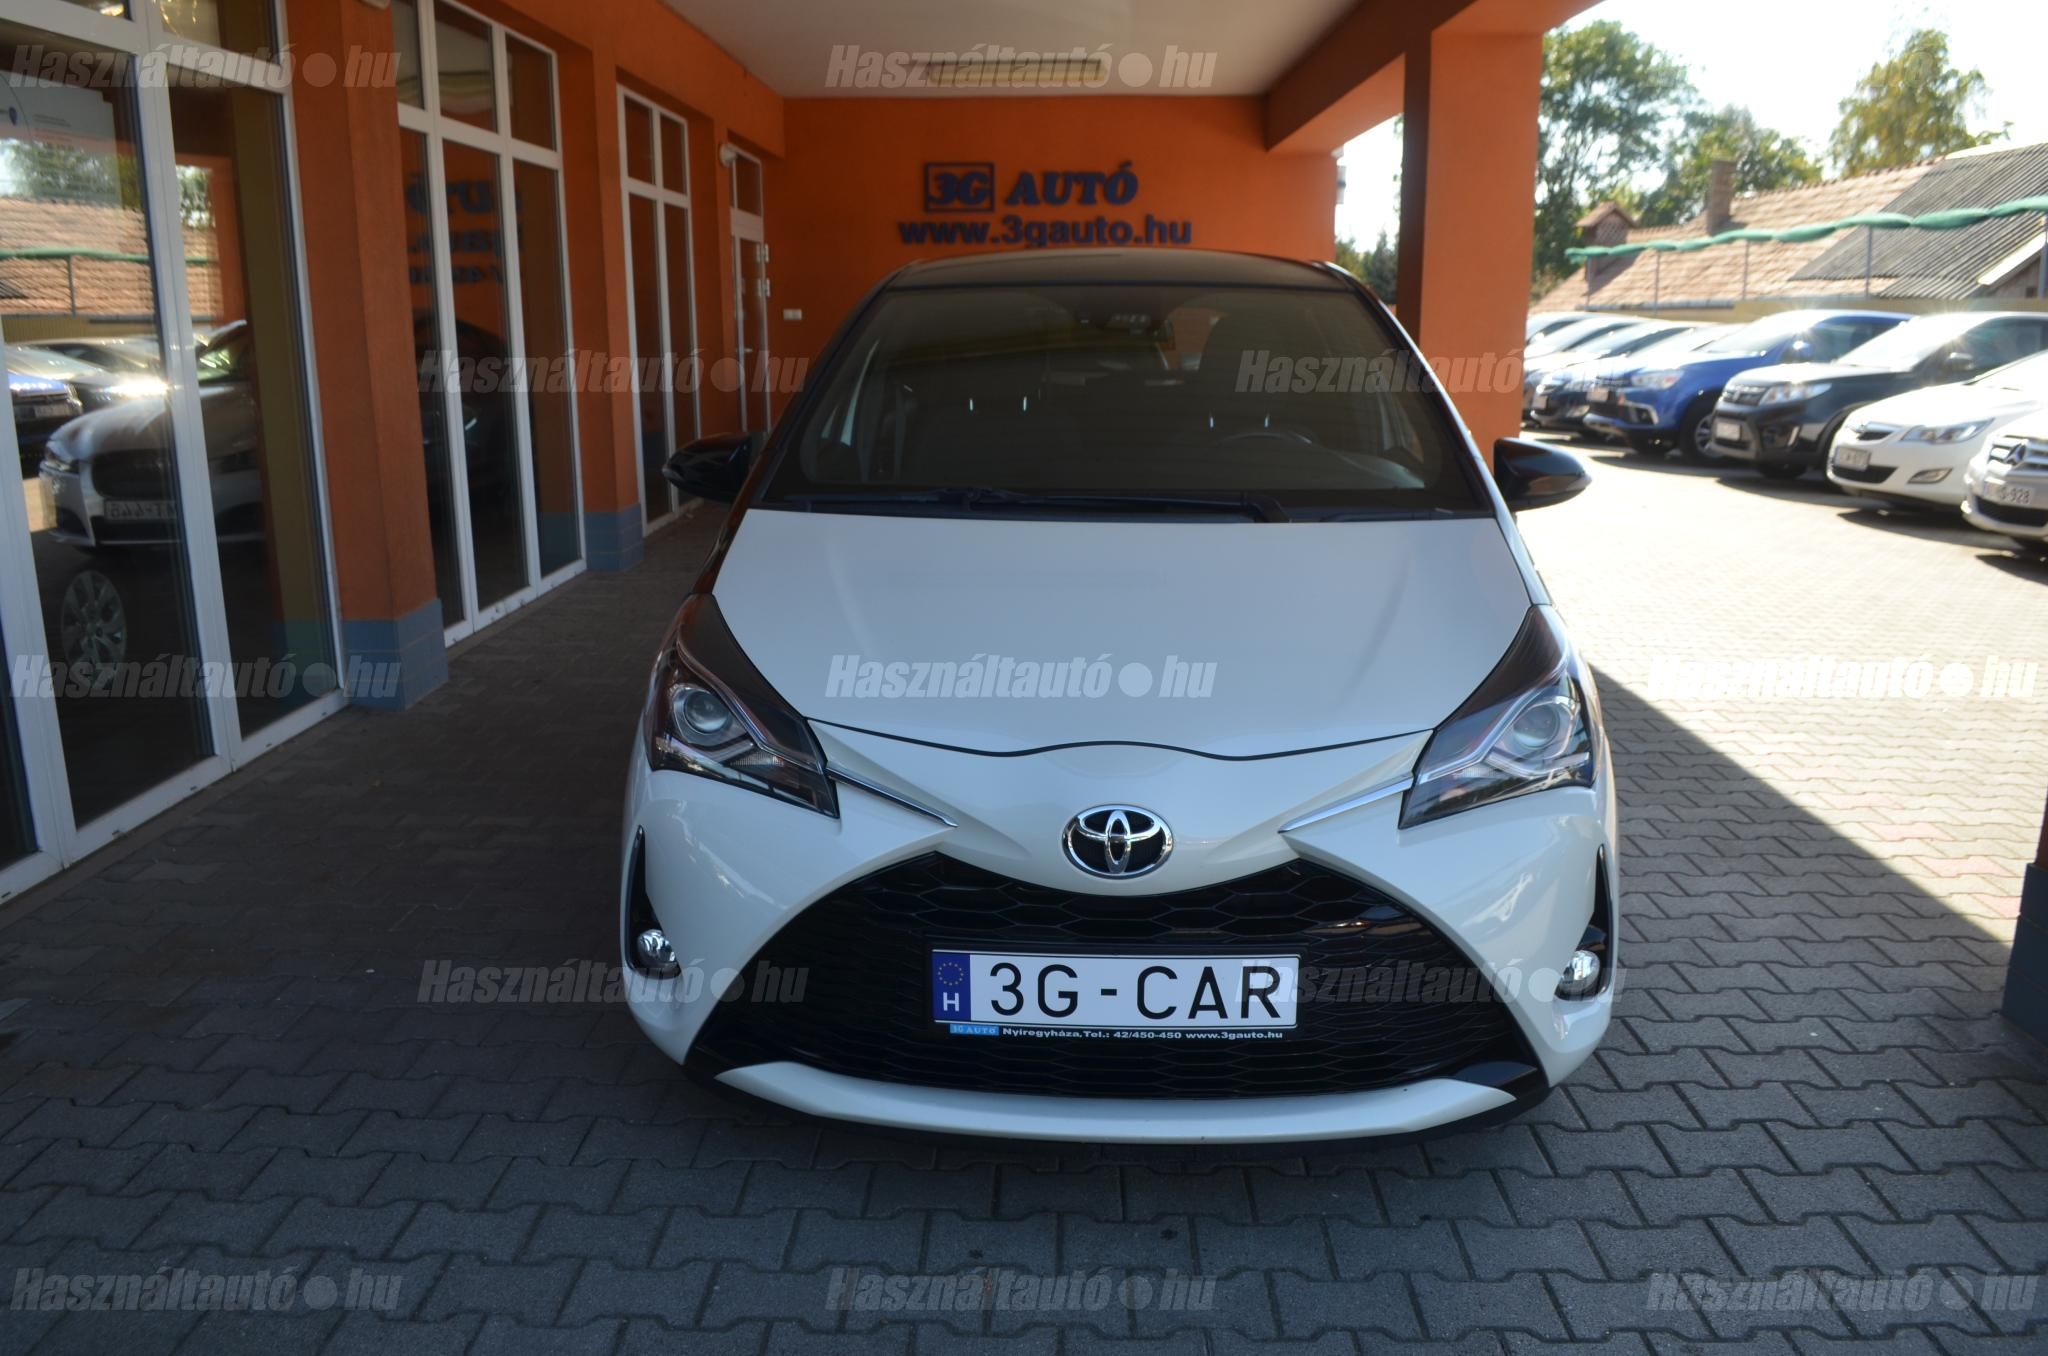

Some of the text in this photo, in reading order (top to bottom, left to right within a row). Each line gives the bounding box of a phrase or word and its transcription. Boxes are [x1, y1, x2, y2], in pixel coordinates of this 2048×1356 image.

[928, 160, 1139, 205] 3G AUTÓ
[898, 213, 1192, 249] www.3gauto.hu
[943, 992, 959, 1012] H
[1113, 1031, 1182, 1040] 42/450-450
[1185, 1031, 1283, 1040] www.3gauto.hu
